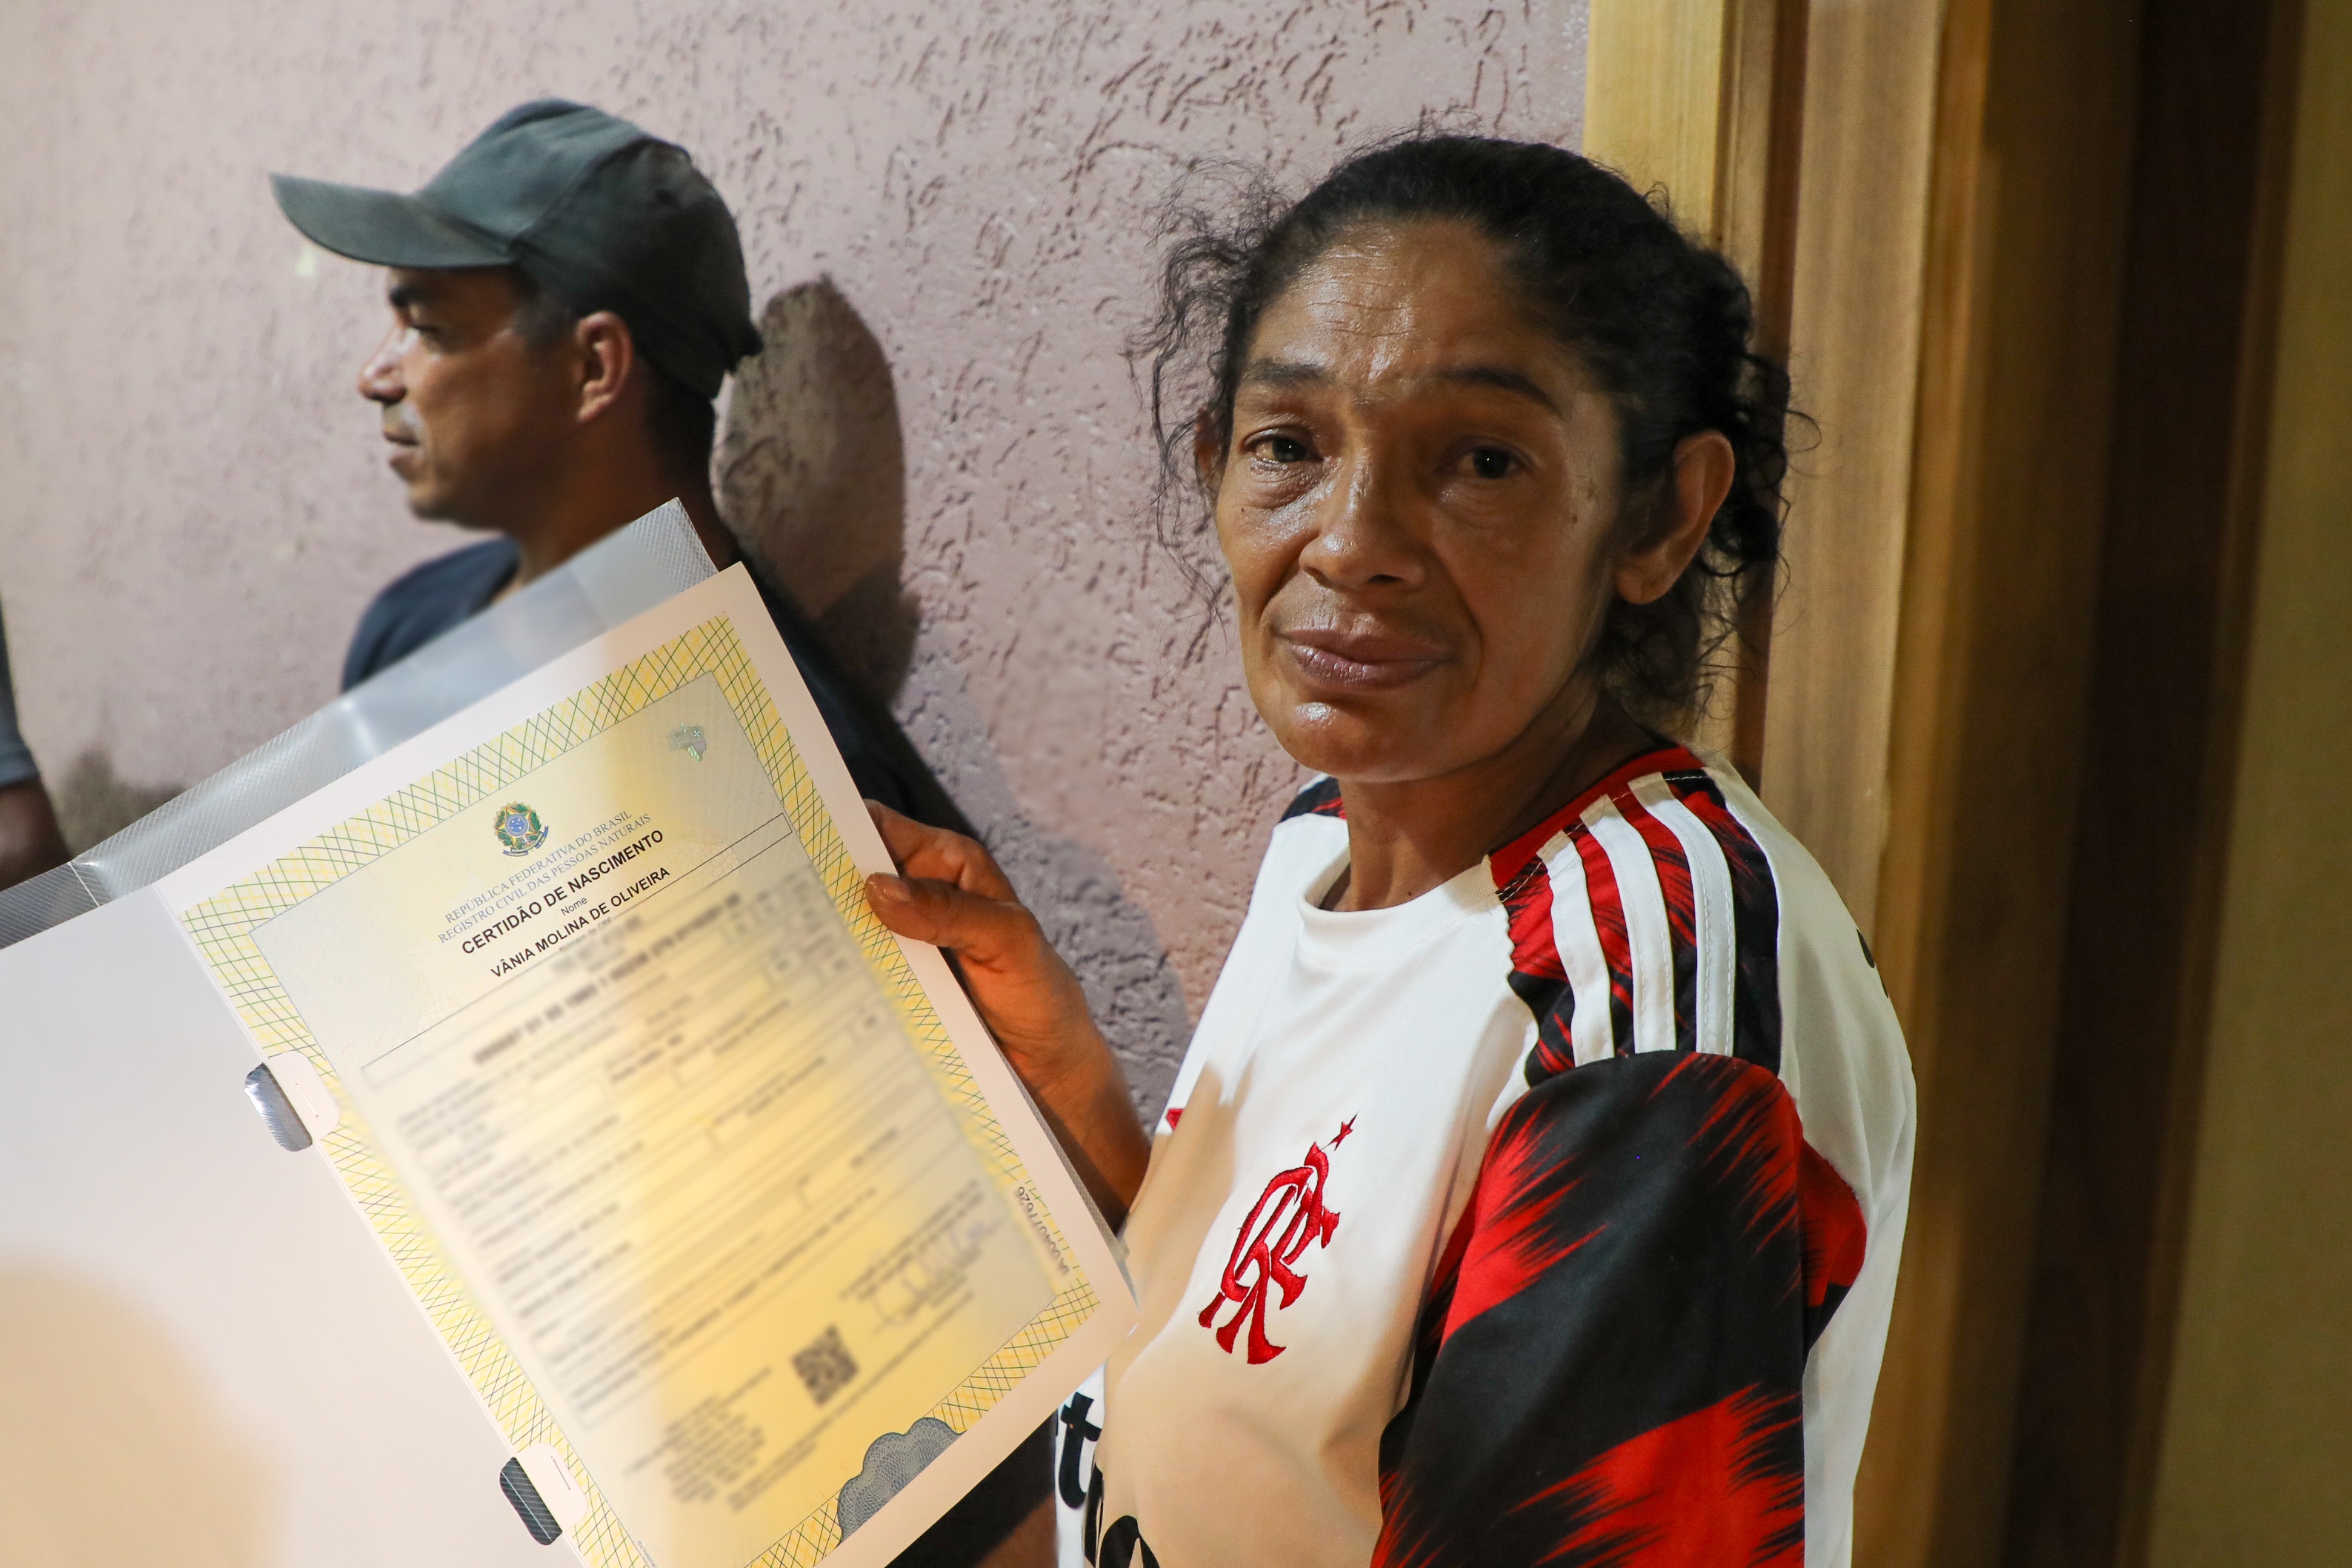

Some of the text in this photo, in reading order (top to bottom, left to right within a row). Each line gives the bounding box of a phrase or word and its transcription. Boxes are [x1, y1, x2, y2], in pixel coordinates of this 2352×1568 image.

[438, 813, 651, 944] REGISTRO CIVIL DAS PESSOAS NATURAIS
[444, 811, 632, 924] REPÚBLICA FEDERATIVA DO BRASIL
[462, 830, 664, 954] CERTIDÃO DE NASCIMENTO
[490, 948, 536, 978] VÂNIA
[535, 915, 590, 953] MOLINA
[589, 902, 610, 921] DE
[610, 867, 670, 907] OLIVEIRA
[560, 897, 587, 916] Nome
